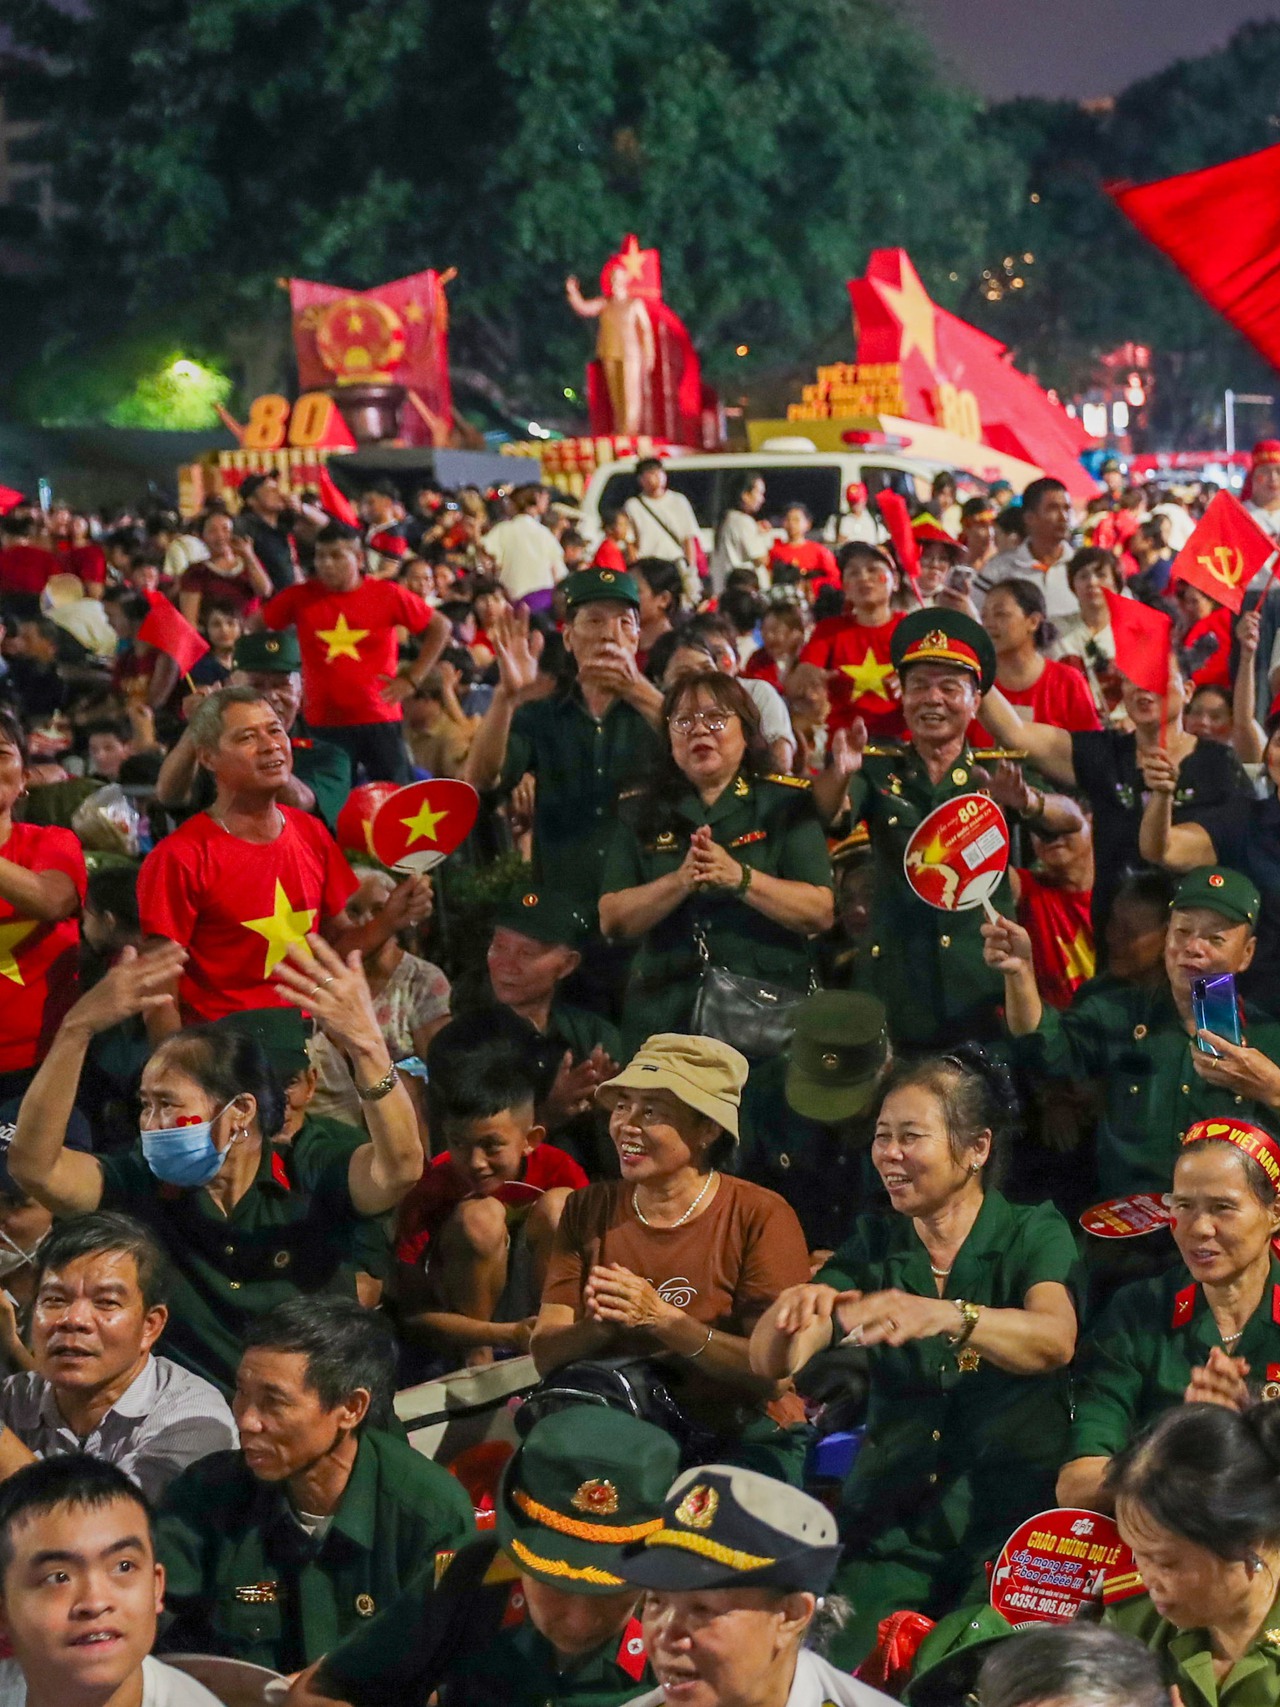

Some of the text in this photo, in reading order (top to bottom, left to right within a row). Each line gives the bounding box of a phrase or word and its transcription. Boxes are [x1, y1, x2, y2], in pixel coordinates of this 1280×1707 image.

[244, 391, 334, 449] 80
[958, 800, 979, 824] 80
[1228, 1128, 1260, 1152] VIỆT
[1256, 1146, 1280, 1181] NAM
[1071, 1518, 1095, 1535] FPT
[1028, 1530, 1057, 1551] CHÀO
[1055, 1537, 1090, 1559] MỪNG
[1105, 1544, 1122, 1565] LỄ
[1011, 1549, 1082, 1573] Lắp mạng FPT
[1020, 1566, 1040, 1580] bao
[1038, 1569, 1072, 1587] phêêê
[1010, 1592, 1078, 1618] 0354.905.022
